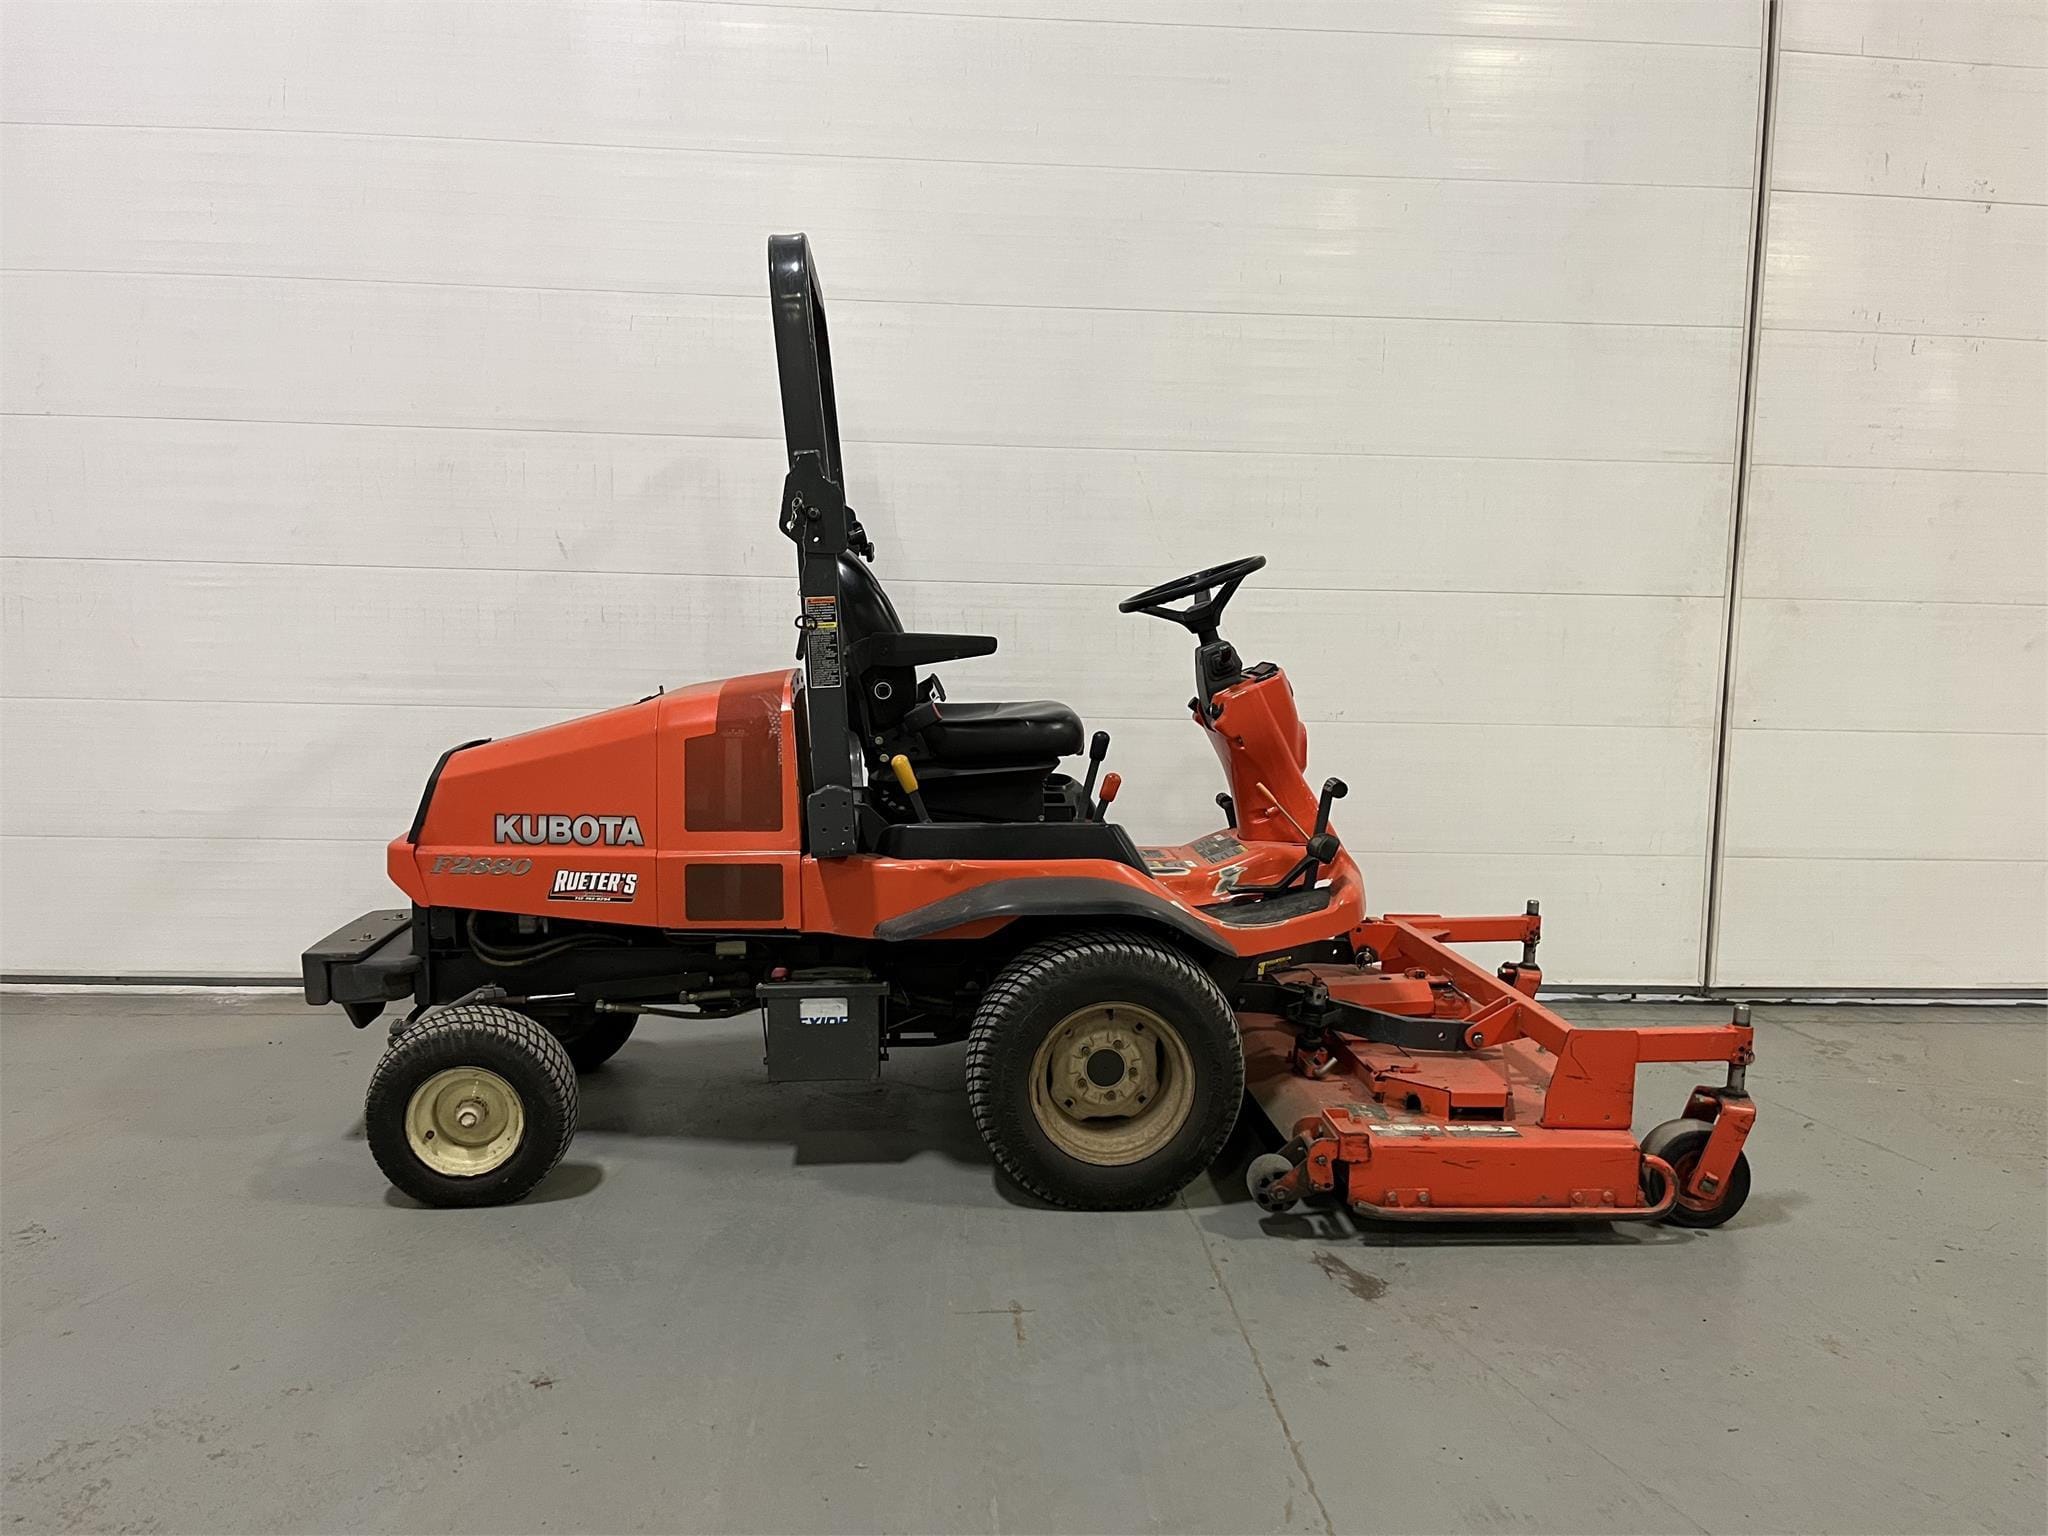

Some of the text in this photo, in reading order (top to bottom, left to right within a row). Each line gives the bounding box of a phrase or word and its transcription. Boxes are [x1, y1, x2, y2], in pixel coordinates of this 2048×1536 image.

[494, 814, 643, 845] KUBOTA
[431, 855, 533, 876] F2880
[554, 870, 638, 894] RUETER'S
